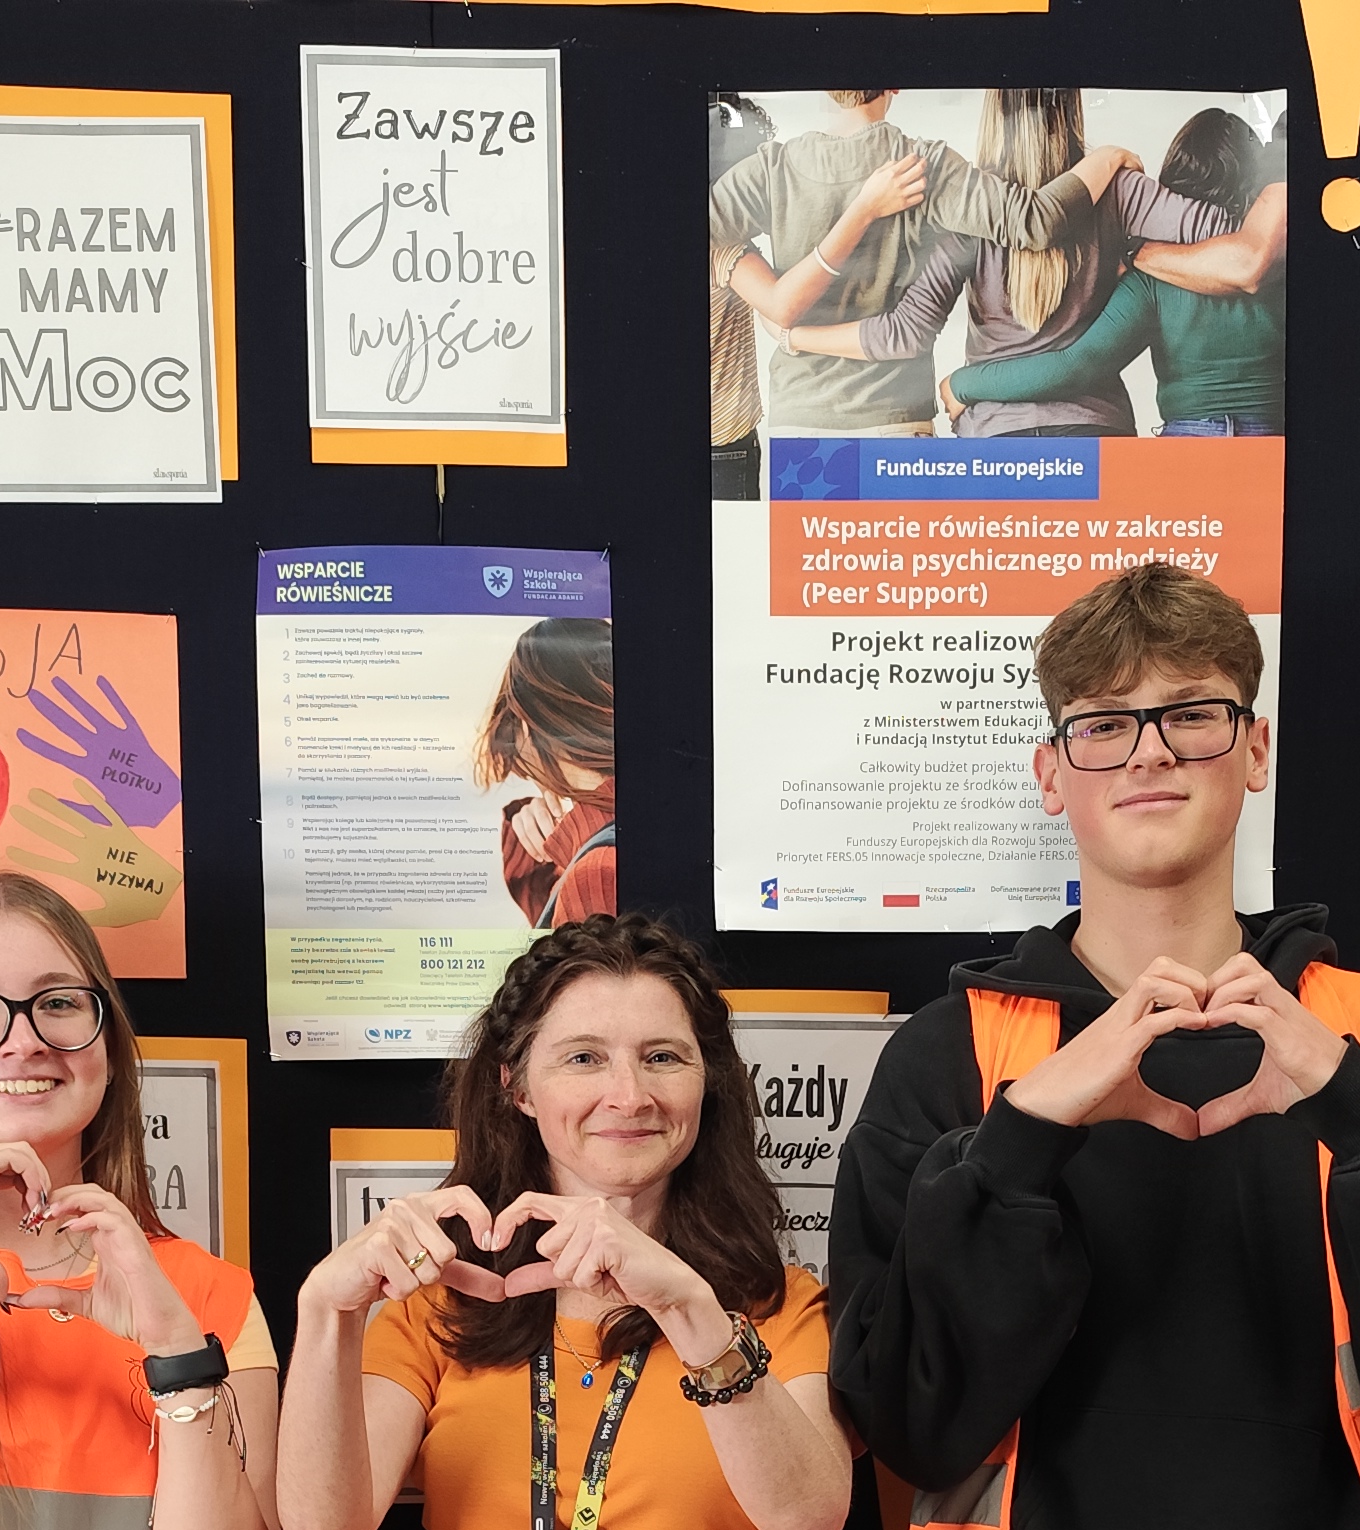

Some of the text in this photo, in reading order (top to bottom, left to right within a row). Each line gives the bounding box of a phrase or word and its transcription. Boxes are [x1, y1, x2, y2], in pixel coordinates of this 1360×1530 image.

[336, 92, 535, 156] Zawsze
[330, 150, 459, 269] jest
[393, 230, 535, 284] dobre
[18, 268, 168, 313] MAMY
[349, 299, 532, 404] wyjście
[876, 459, 1084, 480] Fundusze Europejskie
[802, 515, 1223, 544] Wsparcie rówieśnicze w zakresie
[802, 549, 904, 571] zdrowia
[913, 548, 1082, 576] psychicznego
[277, 561, 365, 580] WSPARCIE
[276, 581, 393, 602] RÓWIEŚNICZE
[523, 580, 557, 590] Szkoła
[802, 582, 988, 608] (Peer Support)
[832, 631, 1040, 657] Projekt realizow
[283, 650, 290, 661] 2
[283, 673, 290, 683] 3
[766, 663, 1040, 690] Fundację Rozwoju Sys
[283, 694, 290, 705] 4
[940, 698, 1048, 712] w partnerstwie
[284, 716, 291, 727] 5
[864, 715, 1042, 730] z Ministerstwem Edukacji
[285, 737, 292, 747] 6
[857, 734, 860, 744] i
[864, 734, 927, 748] Fundacją
[932, 734, 987, 748] Instytut
[108, 747, 138, 767] NIE
[286, 768, 292, 778] 7
[860, 760, 1028, 776] Całkowity budżet projektu:
[102, 765, 163, 795] PLOTKUJ
[782, 779, 1017, 794] Dofinansowanie projektu ze środków
[286, 795, 293, 806] 8
[780, 798, 882, 810] Dofinansowanie
[886, 798, 939, 812] projektu
[944, 800, 956, 810] ze
[961, 798, 1014, 810] środków
[287, 818, 294, 828] 9
[912, 822, 950, 834] Projekt
[954, 821, 1017, 833] realizowany
[846, 836, 1076, 848] Funduszy Europejskich dla Rozwoju Społec
[106, 847, 137, 866] NIE
[283, 849, 295, 859] 10
[776, 850, 1079, 864] Priorytet FERS.05 Innowacje społeczne, Działanie FERS.05
[96, 868, 164, 895] WYZYWAJ
[420, 937, 452, 947] 116 111
[421, 959, 485, 969] 800 121 212
[384, 1029, 411, 1039] NPZ
[539, 1355, 550, 1402] 888 500 444
[606, 1405, 619, 1421] 500
[600, 1422, 612, 1440] 444
